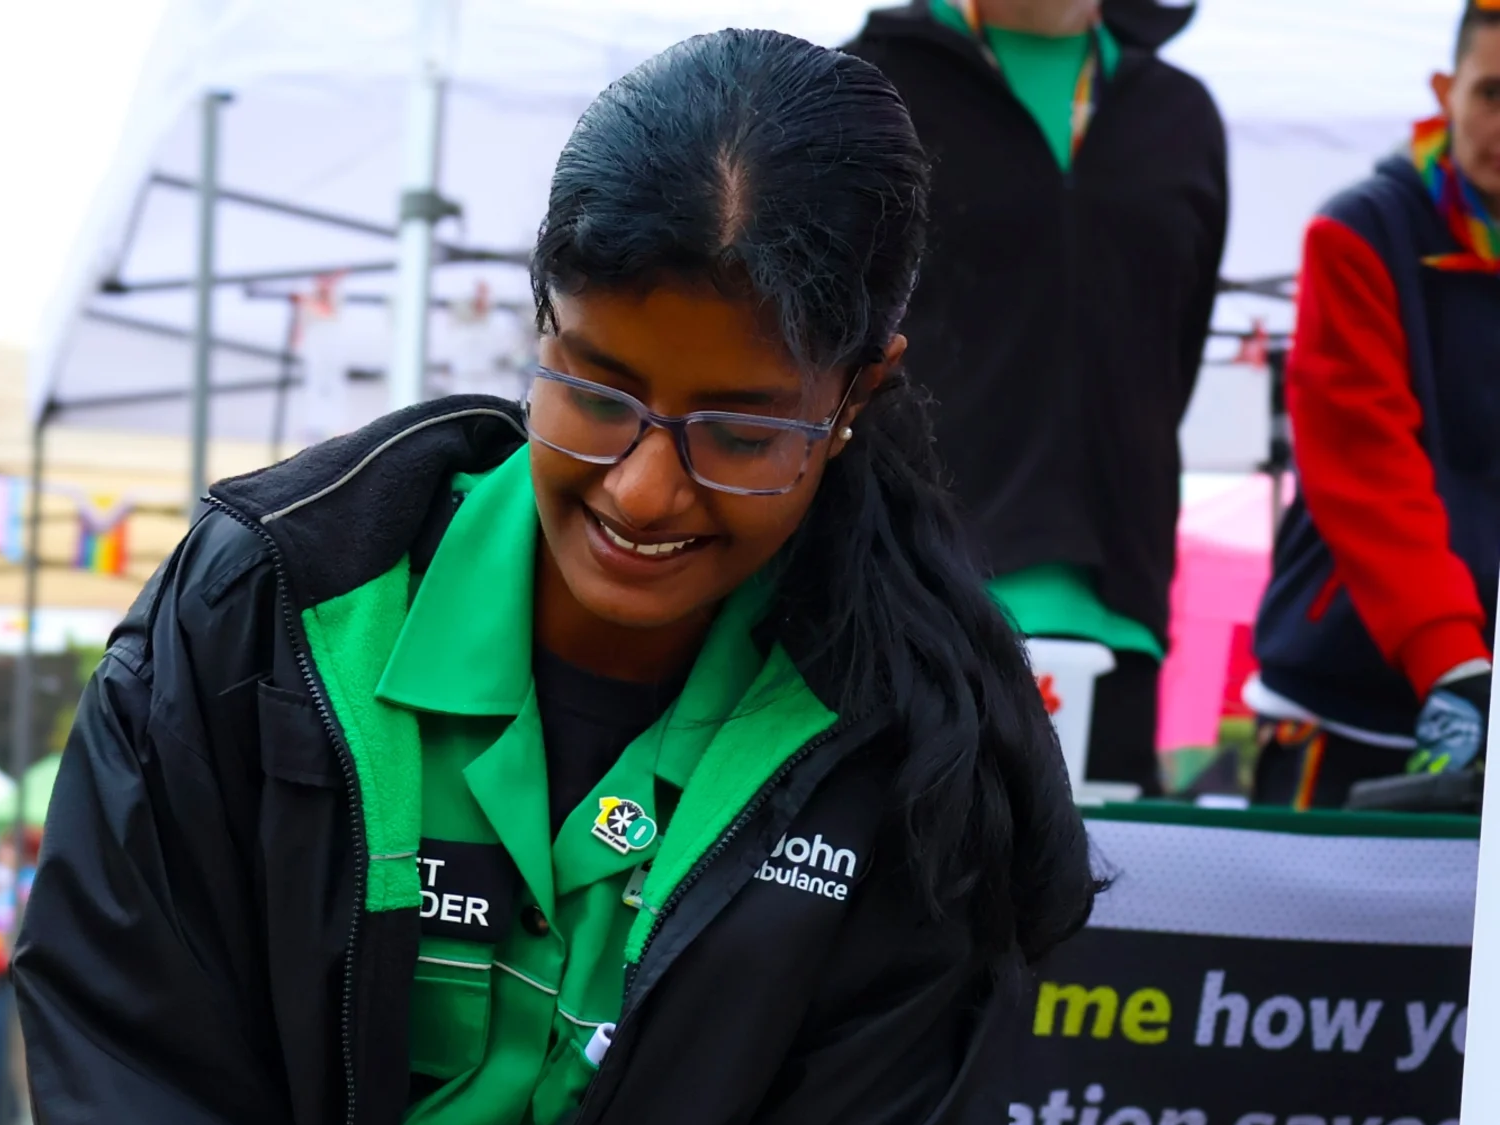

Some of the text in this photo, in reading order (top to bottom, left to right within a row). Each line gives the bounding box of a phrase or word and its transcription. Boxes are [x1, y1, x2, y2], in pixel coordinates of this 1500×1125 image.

[416, 857, 445, 887] T
[754, 860, 848, 901] bulance
[1032, 981, 1171, 1044] me
[1195, 970, 1382, 1052] how
